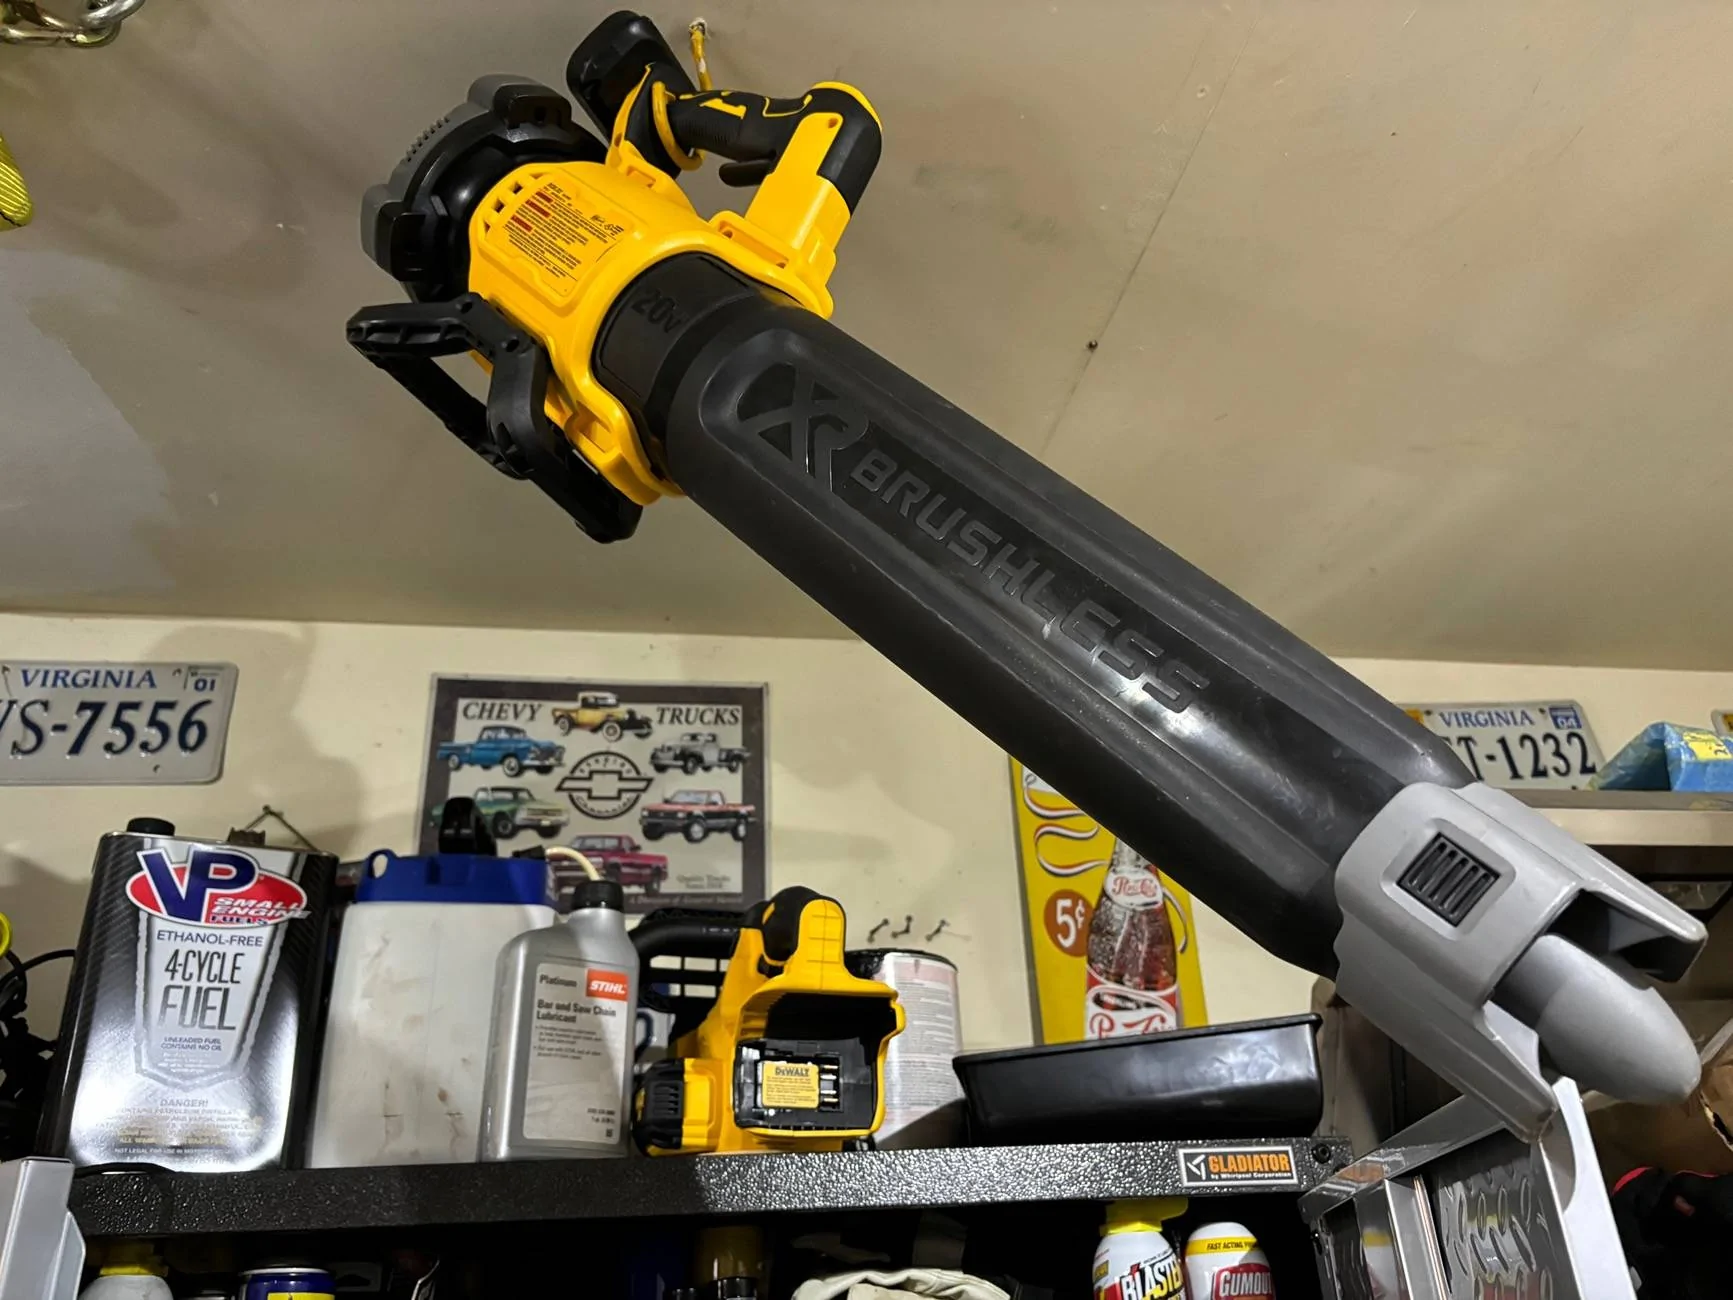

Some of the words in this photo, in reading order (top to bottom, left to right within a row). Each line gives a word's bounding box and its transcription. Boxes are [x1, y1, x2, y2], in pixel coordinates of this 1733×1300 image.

[850, 448, 1210, 713] BRUSHLESS
[21, 668, 158, 689] VIRGINIA
[462, 701, 543, 722] CHEVY
[656, 706, 741, 726] TRUCKS
[1439, 708, 1536, 728] VIRGINIA
[1443, 731, 1597, 782] T-1232
[137, 849, 259, 925] VP
[212, 905, 312, 919] ENGINE
[214, 897, 299, 909] SMALL
[210, 915, 269, 926] FUELS
[156, 930, 264, 948] ETHANOL-FREE
[164, 949, 245, 985] 4-CYCLE
[539, 974, 577, 988] Platinum
[589, 980, 627, 995] STIHL
[157, 985, 237, 1031] FUEL
[536, 1010, 577, 1023] Lubricant
[537, 999, 554, 1010] Bar
[555, 1001, 571, 1011] and
[573, 1003, 591, 1014] Saw
[593, 1005, 617, 1017] Chain
[159, 1099, 209, 1107] DANGER!
[1208, 1152, 1291, 1174] GLADIATOR
[1210, 1173, 1219, 1181] by
[1220, 1172, 1252, 1180] Whirlpool
[1253, 1171, 1292, 1179] Corporation
[1206, 1242, 1222, 1250] FAST
